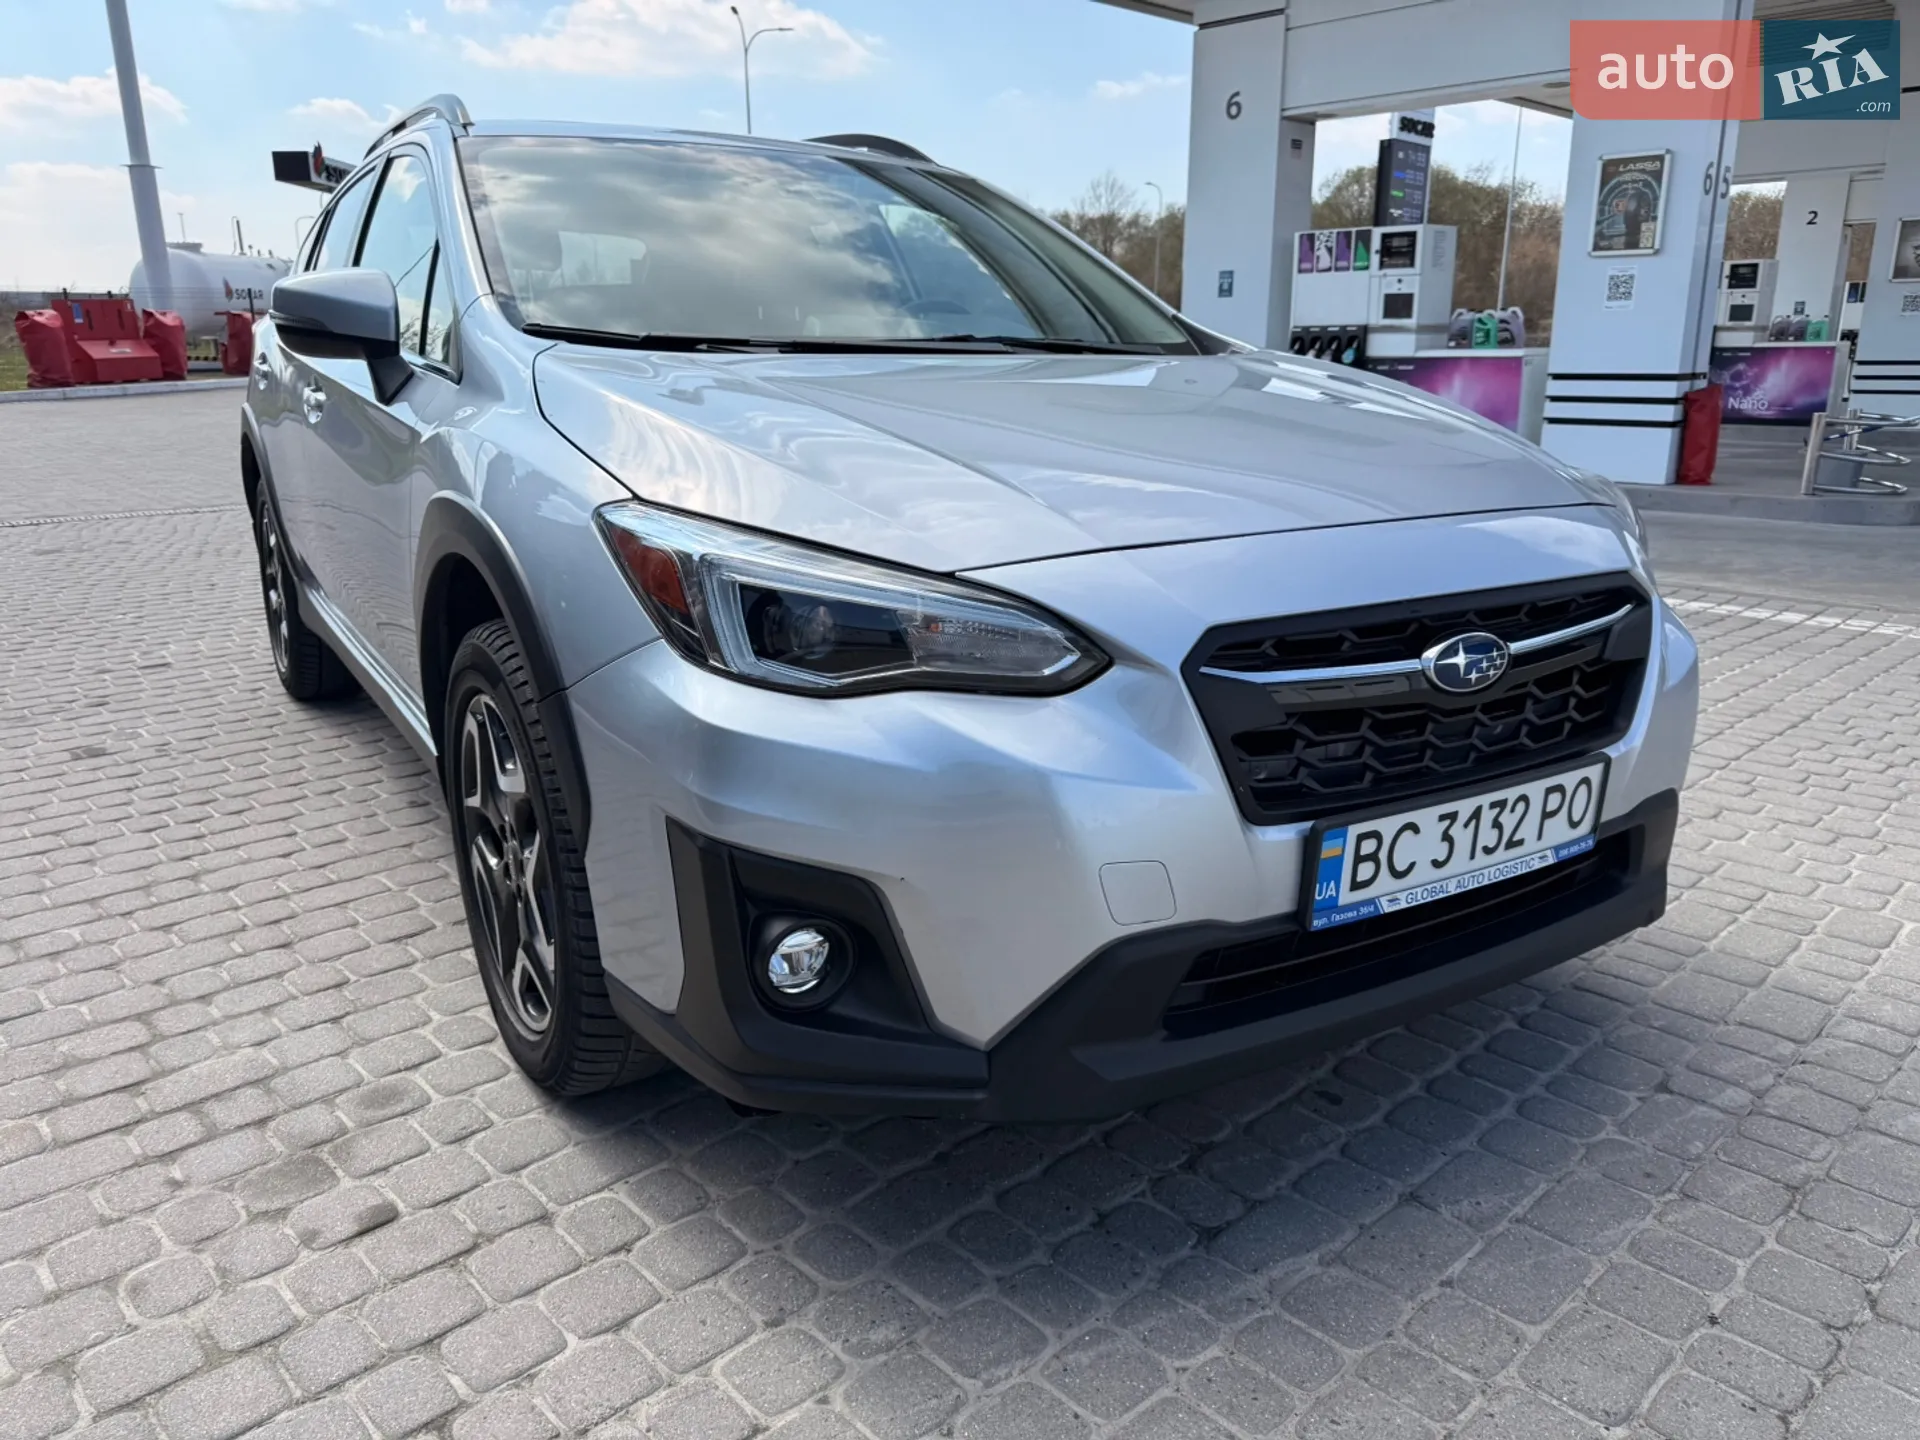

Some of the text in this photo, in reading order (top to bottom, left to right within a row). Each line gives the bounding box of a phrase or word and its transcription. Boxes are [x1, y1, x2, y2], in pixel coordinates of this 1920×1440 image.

[1226, 91, 1242, 120] 6
[1618, 160, 1661, 172] LASSA
[1703, 161, 1714, 196] 6
[1720, 165, 1731, 199] 5
[1806, 210, 1819, 226] 2
[1727, 396, 1769, 410] Nano
[1349, 776, 1593, 892] BC 3132 PO
[1315, 880, 1337, 900] UA
[1405, 857, 1535, 905] GLOBAL AUTO LOGISTIC
